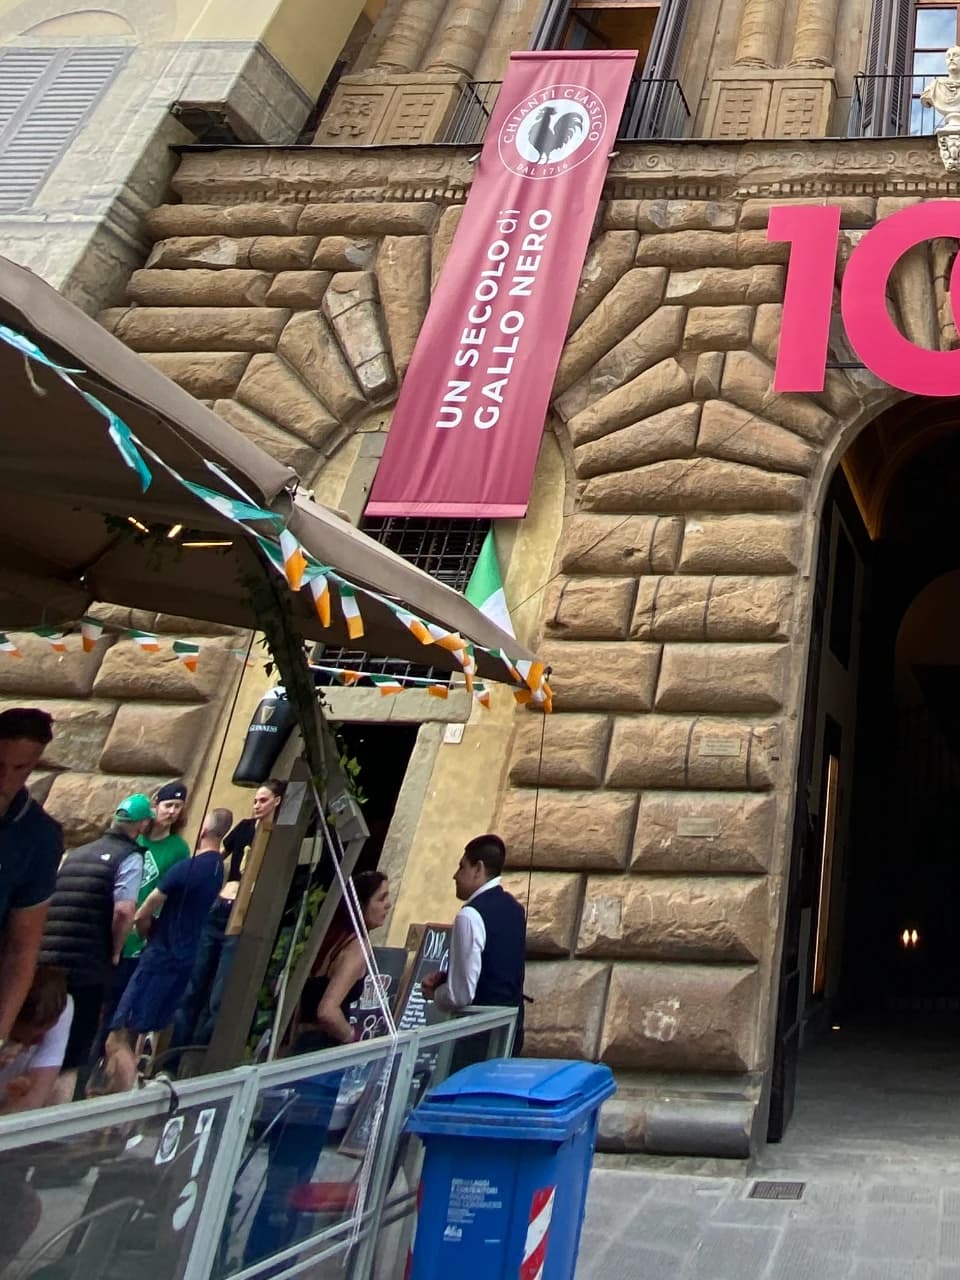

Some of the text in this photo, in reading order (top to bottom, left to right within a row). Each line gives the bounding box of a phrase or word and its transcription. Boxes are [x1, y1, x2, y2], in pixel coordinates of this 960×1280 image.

[504, 89, 603, 143] CHIANTI CLASSICO
[516, 163, 536, 175] DAL
[436, 209, 521, 428] UN SECOLO di
[473, 209, 553, 429] GALLO NERO
